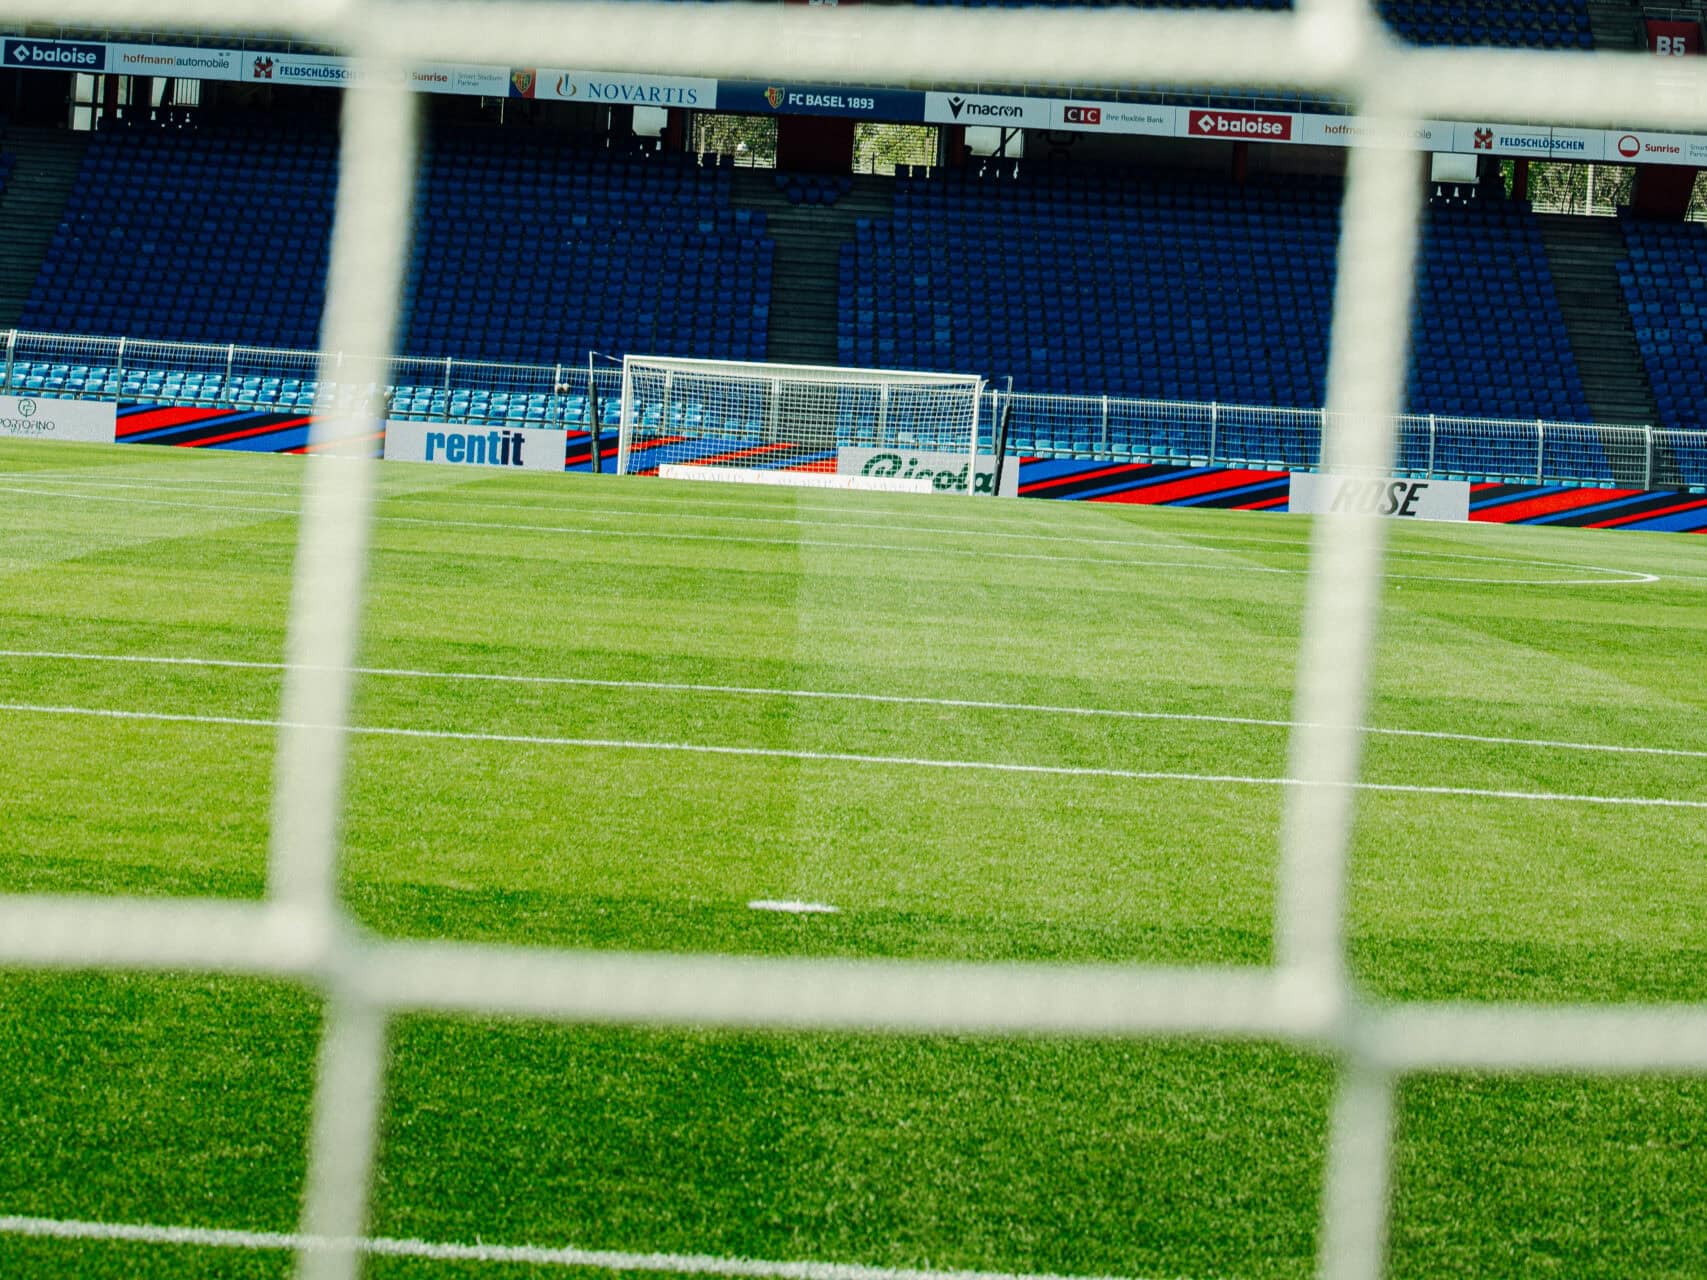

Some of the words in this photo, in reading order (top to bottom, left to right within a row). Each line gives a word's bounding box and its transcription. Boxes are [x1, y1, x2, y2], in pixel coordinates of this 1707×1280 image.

[1656, 35, 1686, 57] B5
[32, 46, 97, 65] baloise
[412, 72, 448, 82] Sunrise
[588, 83, 698, 105] NOVARTIS
[789, 92, 803, 107] FC
[805, 93, 845, 108] BASEL
[847, 96, 875, 110] 1893
[967, 102, 1023, 119] macron
[1067, 108, 1098, 123] CIC
[1217, 118, 1284, 135] baloise
[1500, 136, 1585, 151] FELDSCHLÖSSCHEN
[1645, 143, 1680, 154] Sunrise
[425, 430, 525, 466] rentit
[1330, 479, 1429, 517] ROSE
